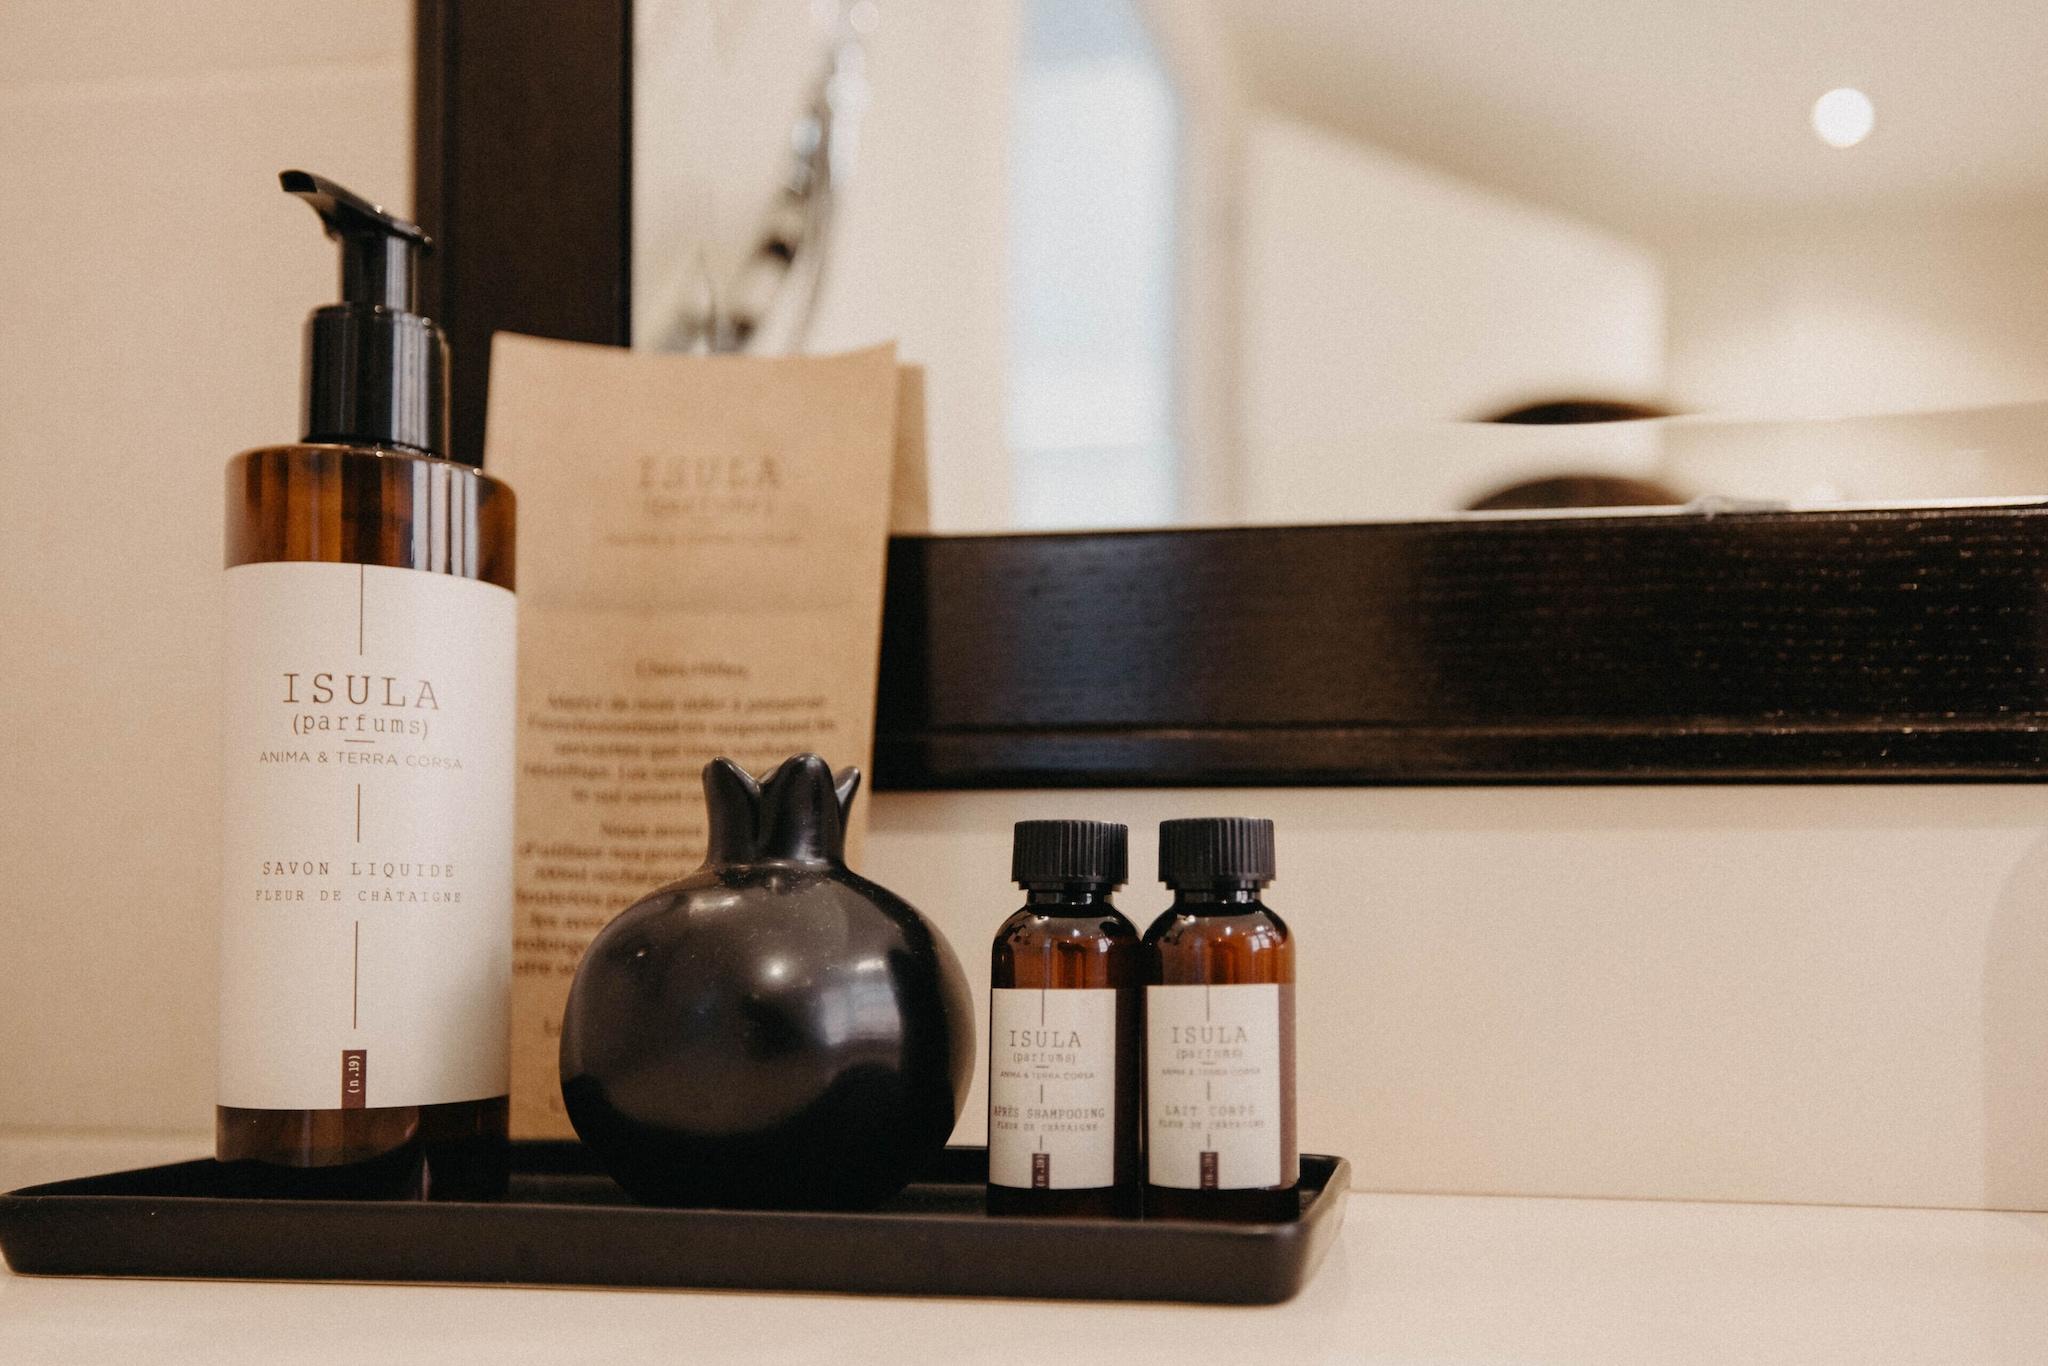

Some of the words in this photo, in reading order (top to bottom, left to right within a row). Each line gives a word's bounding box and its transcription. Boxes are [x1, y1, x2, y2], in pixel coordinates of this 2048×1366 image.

[282, 672, 439, 710] ISULA
[292, 713, 429, 741] (parfums)
[259, 751, 311, 764] ANIMA
[317, 752, 329, 764] &
[336, 751, 399, 766] TERRA
[406, 754, 464, 770] CORSA
[262, 861, 330, 876] SAVON
[350, 862, 455, 879] LIQUIDE
[255, 889, 305, 902] FLEUR
[319, 890, 342, 902] DE
[1009, 1029, 1082, 1048] ISULA
[1172, 1025, 1248, 1044] ISULA
[1026, 1107, 1105, 1120] SHAMPOOING
